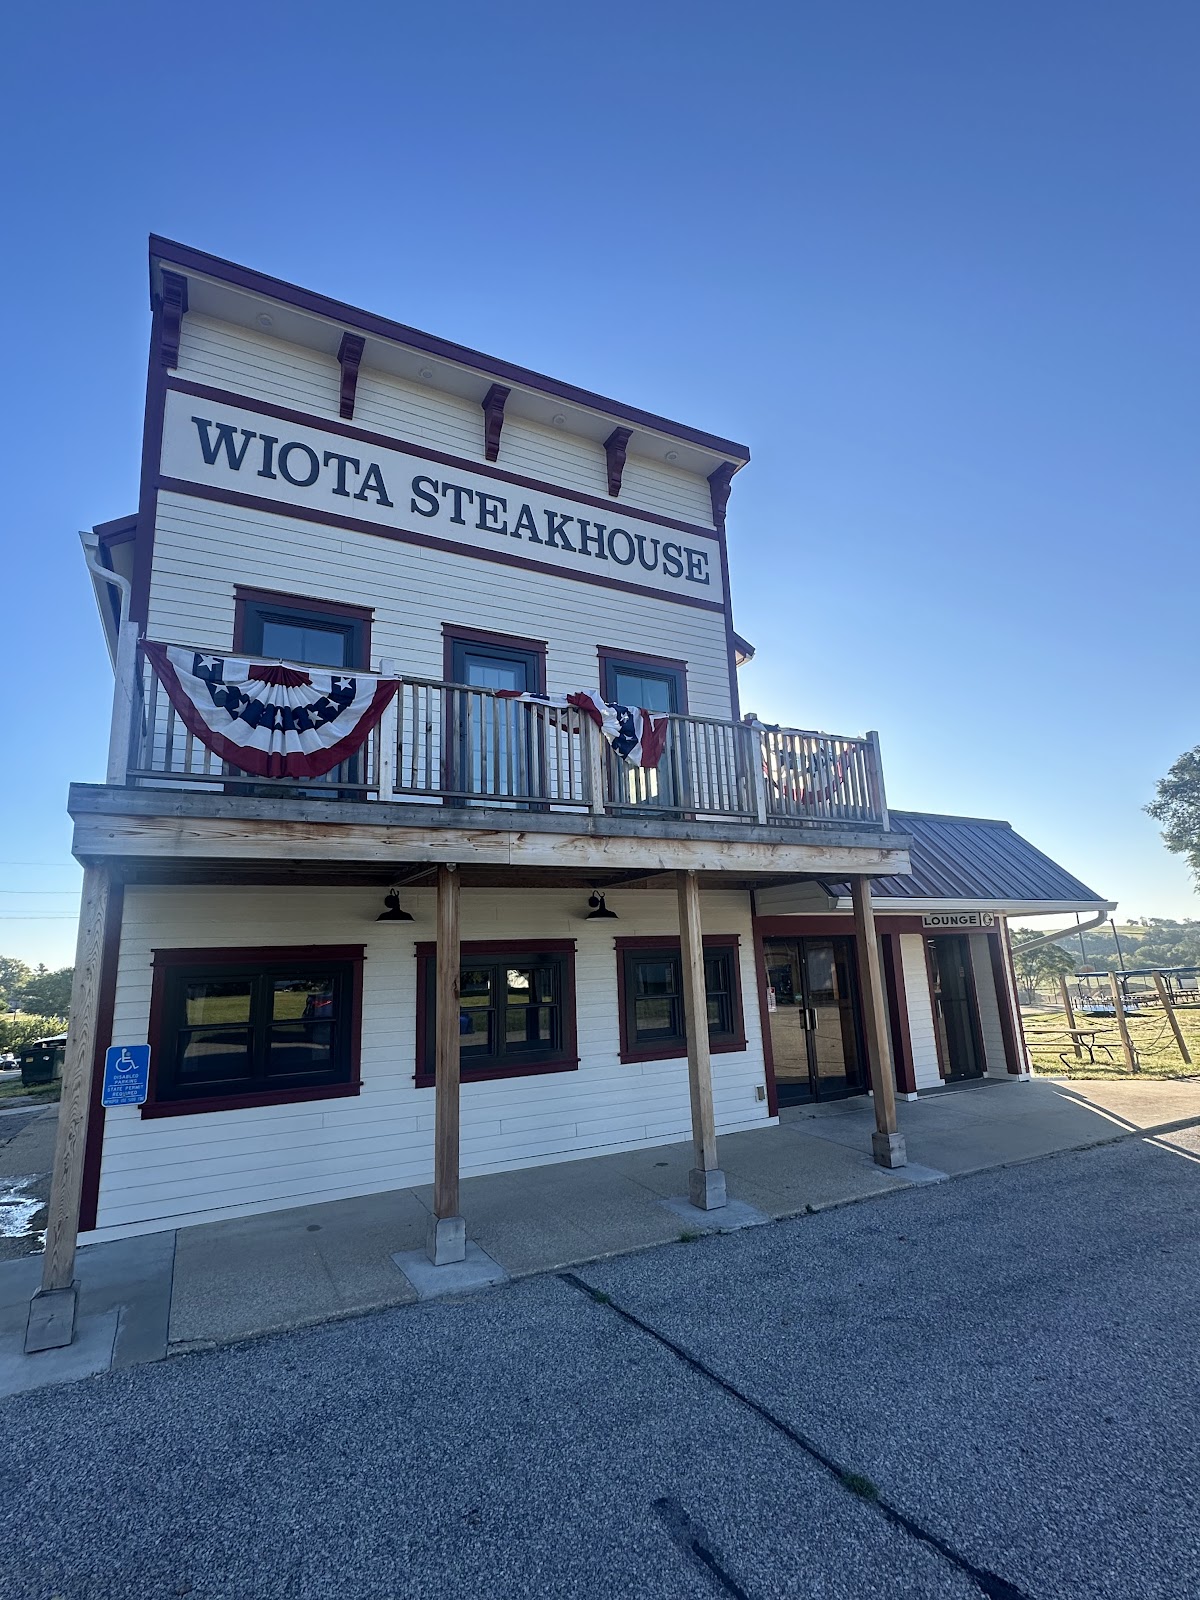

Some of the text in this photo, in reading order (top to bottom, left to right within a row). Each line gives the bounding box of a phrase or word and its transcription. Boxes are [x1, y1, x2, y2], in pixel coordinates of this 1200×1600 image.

[191, 416, 710, 586] WIOTA STEAKHOUSE
[924, 915, 977, 926] LOUNGE
